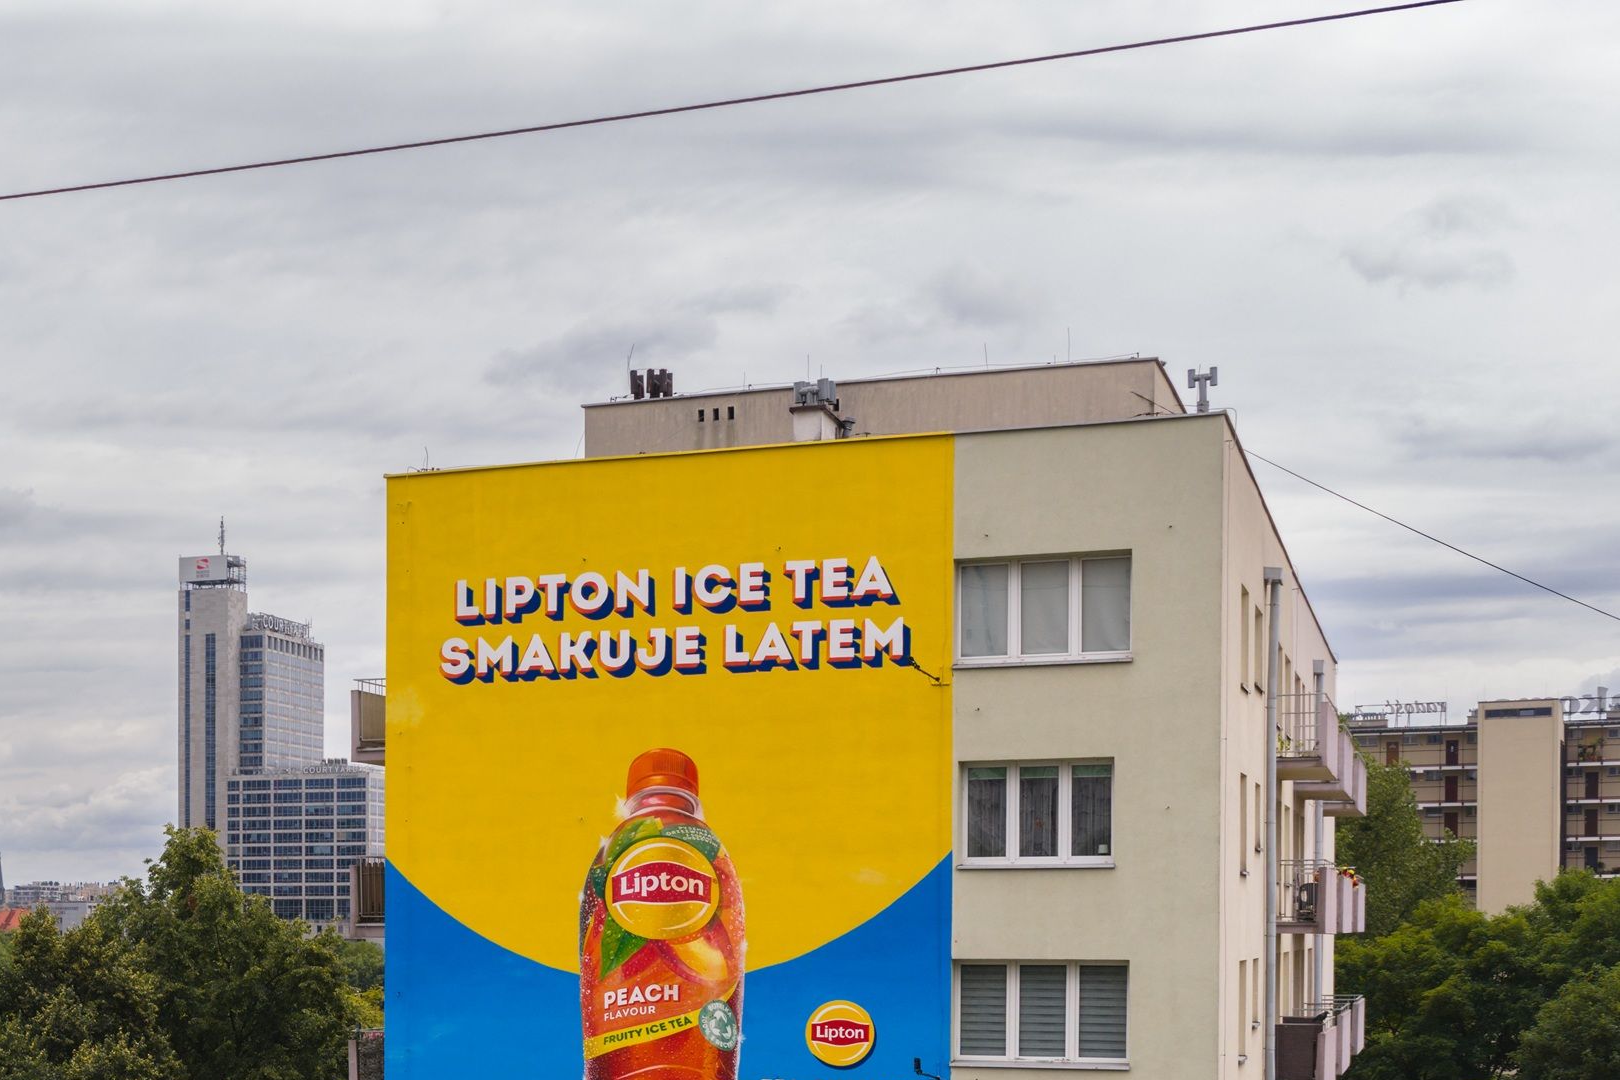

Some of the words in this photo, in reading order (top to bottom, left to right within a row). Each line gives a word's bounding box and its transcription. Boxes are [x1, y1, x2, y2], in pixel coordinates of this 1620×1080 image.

[454, 568, 655, 626] LIPTON
[672, 561, 771, 615] ICE
[784, 555, 901, 609] TEA
[438, 626, 706, 686] SMAKUJE
[723, 616, 912, 674] LATEM
[620, 872, 704, 897] Lipton
[603, 983, 679, 1009] PEACH
[604, 1005, 656, 1022] FLAVOUR
[603, 1028, 642, 1045] FRUITY
[646, 1022, 666, 1035] ICE
[668, 1016, 693, 1030] TEA
[816, 1025, 864, 1041] Lipton
